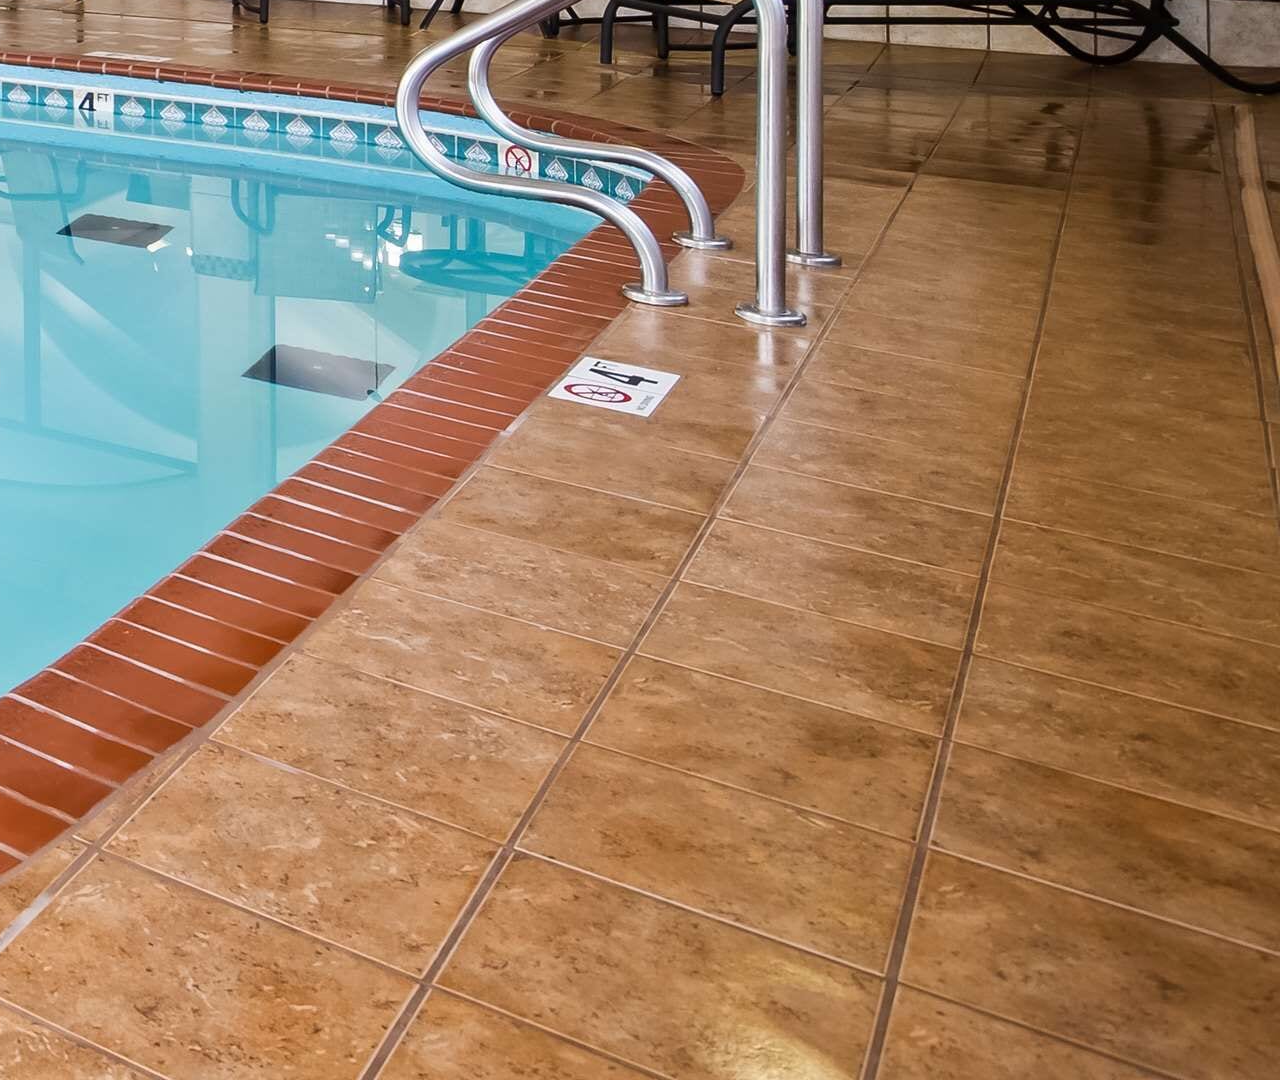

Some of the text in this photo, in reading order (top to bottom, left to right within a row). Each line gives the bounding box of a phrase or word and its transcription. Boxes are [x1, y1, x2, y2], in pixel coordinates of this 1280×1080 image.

[79, 92, 110, 111] 4 FT
[589, 368, 658, 386] 4
